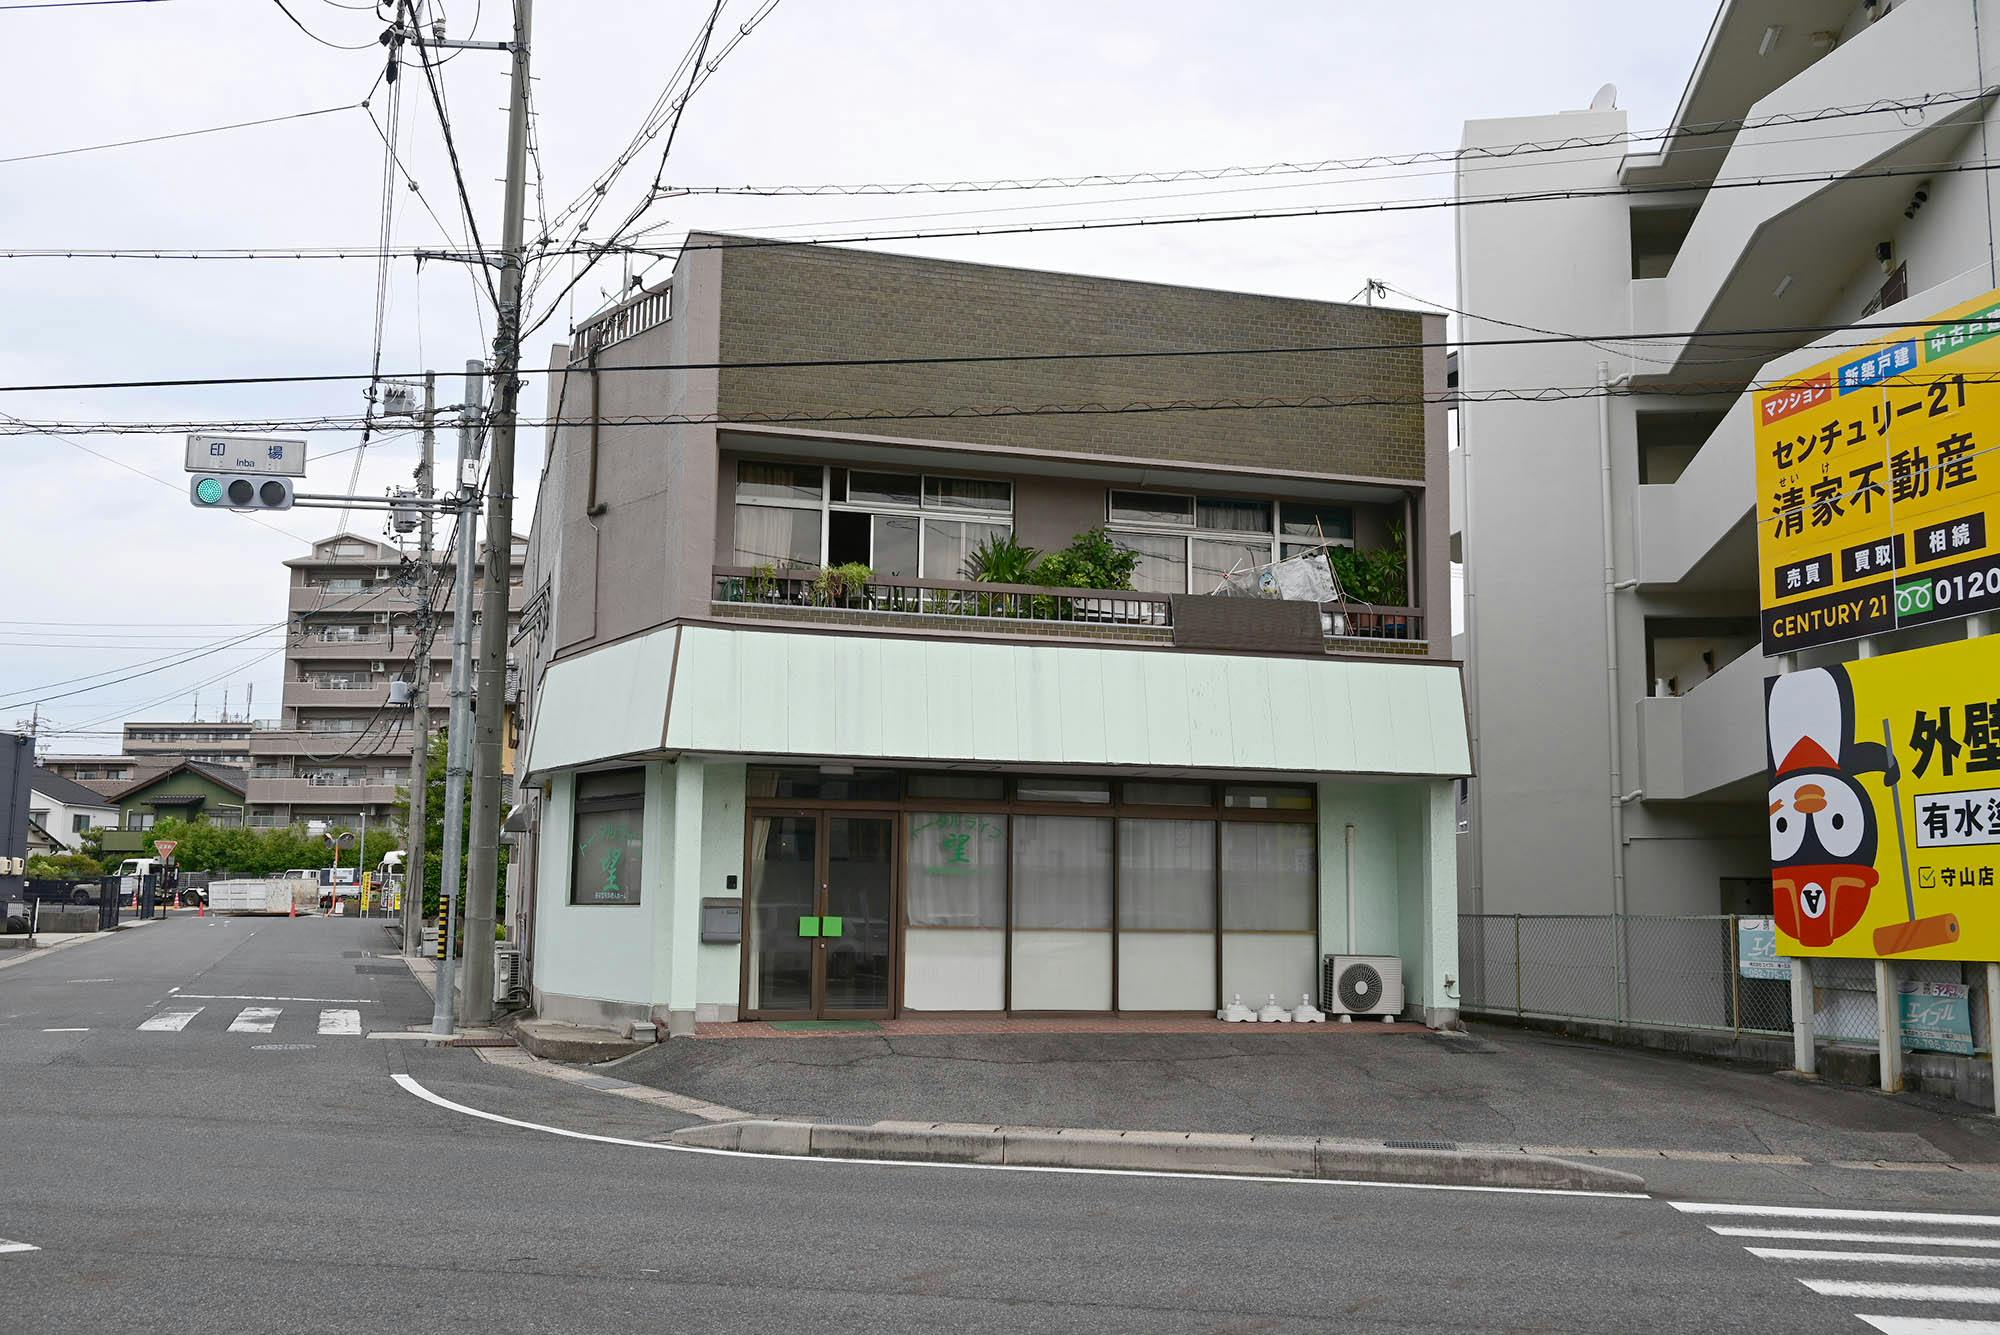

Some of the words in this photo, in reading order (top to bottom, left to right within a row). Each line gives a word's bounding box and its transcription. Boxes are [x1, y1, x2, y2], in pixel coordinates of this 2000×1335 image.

[1845, 347, 1909, 386] 新築戸建
[1765, 383, 1826, 417] マンション
[1772, 374, 1966, 470] センチュリー21
[210, 442, 284, 460] 印場
[236, 458, 255, 468] Inba
[1772, 432, 1978, 539] 清家不動産
[1929, 523, 1971, 553] 相続
[1854, 544, 1891, 573] 買取
[1786, 562, 1821, 590] 売買
[1772, 599, 1864, 639] CENTURY
[1869, 594, 1888, 619] 21
[1940, 866, 1994, 887] 守山店
[1803, 890, 1822, 913] A
